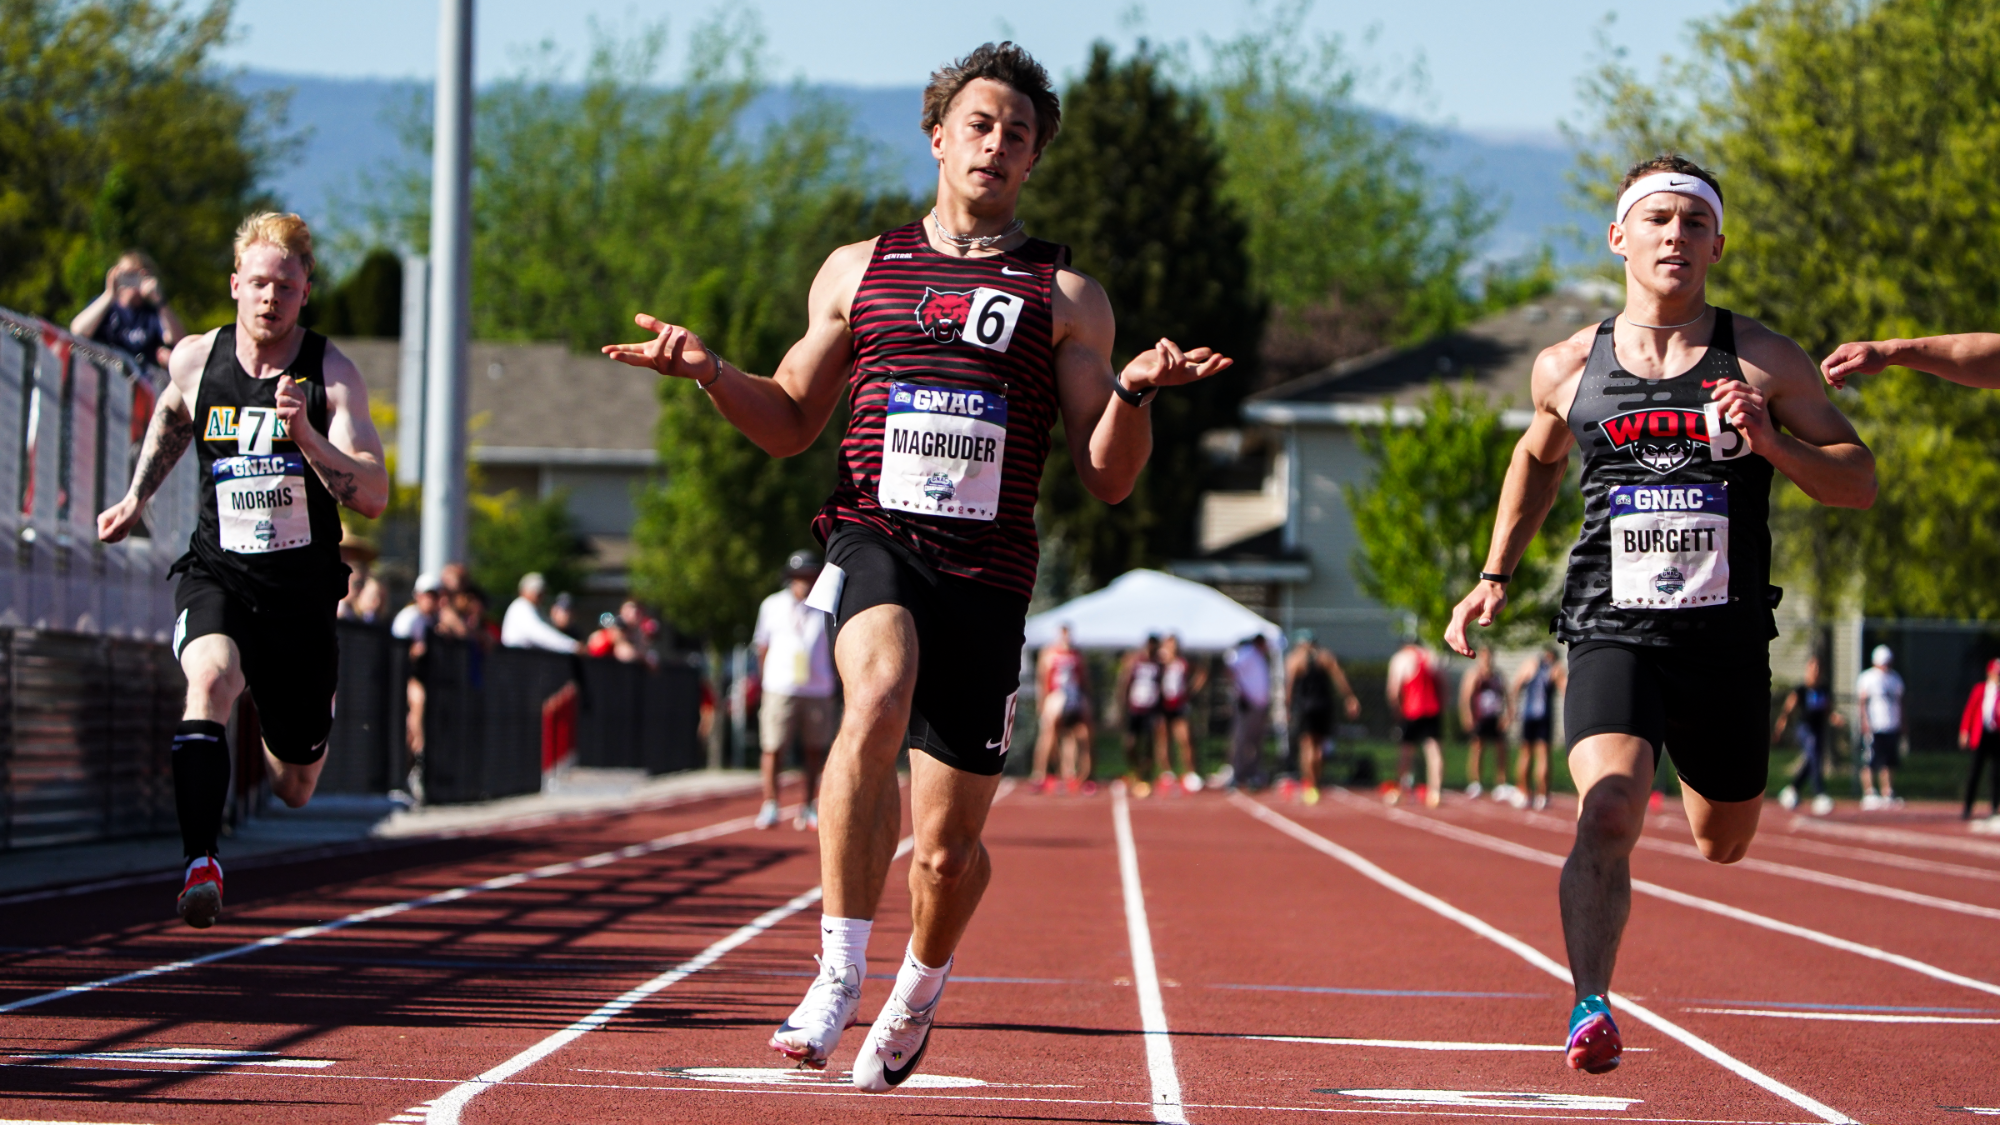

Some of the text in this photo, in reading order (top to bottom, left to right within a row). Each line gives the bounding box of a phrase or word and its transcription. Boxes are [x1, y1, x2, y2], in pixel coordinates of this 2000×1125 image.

[976, 294, 1012, 345] 6
[913, 389, 984, 416] GNAC
[247, 410, 267, 452] 7
[1719, 411, 1745, 458] 5
[891, 428, 996, 463] MAGRUDER
[231, 456, 286, 477] GNAC
[231, 487, 293, 511] MORRIS
[1634, 488, 1703, 510] GNAC
[1624, 528, 1716, 553] BURGETT
